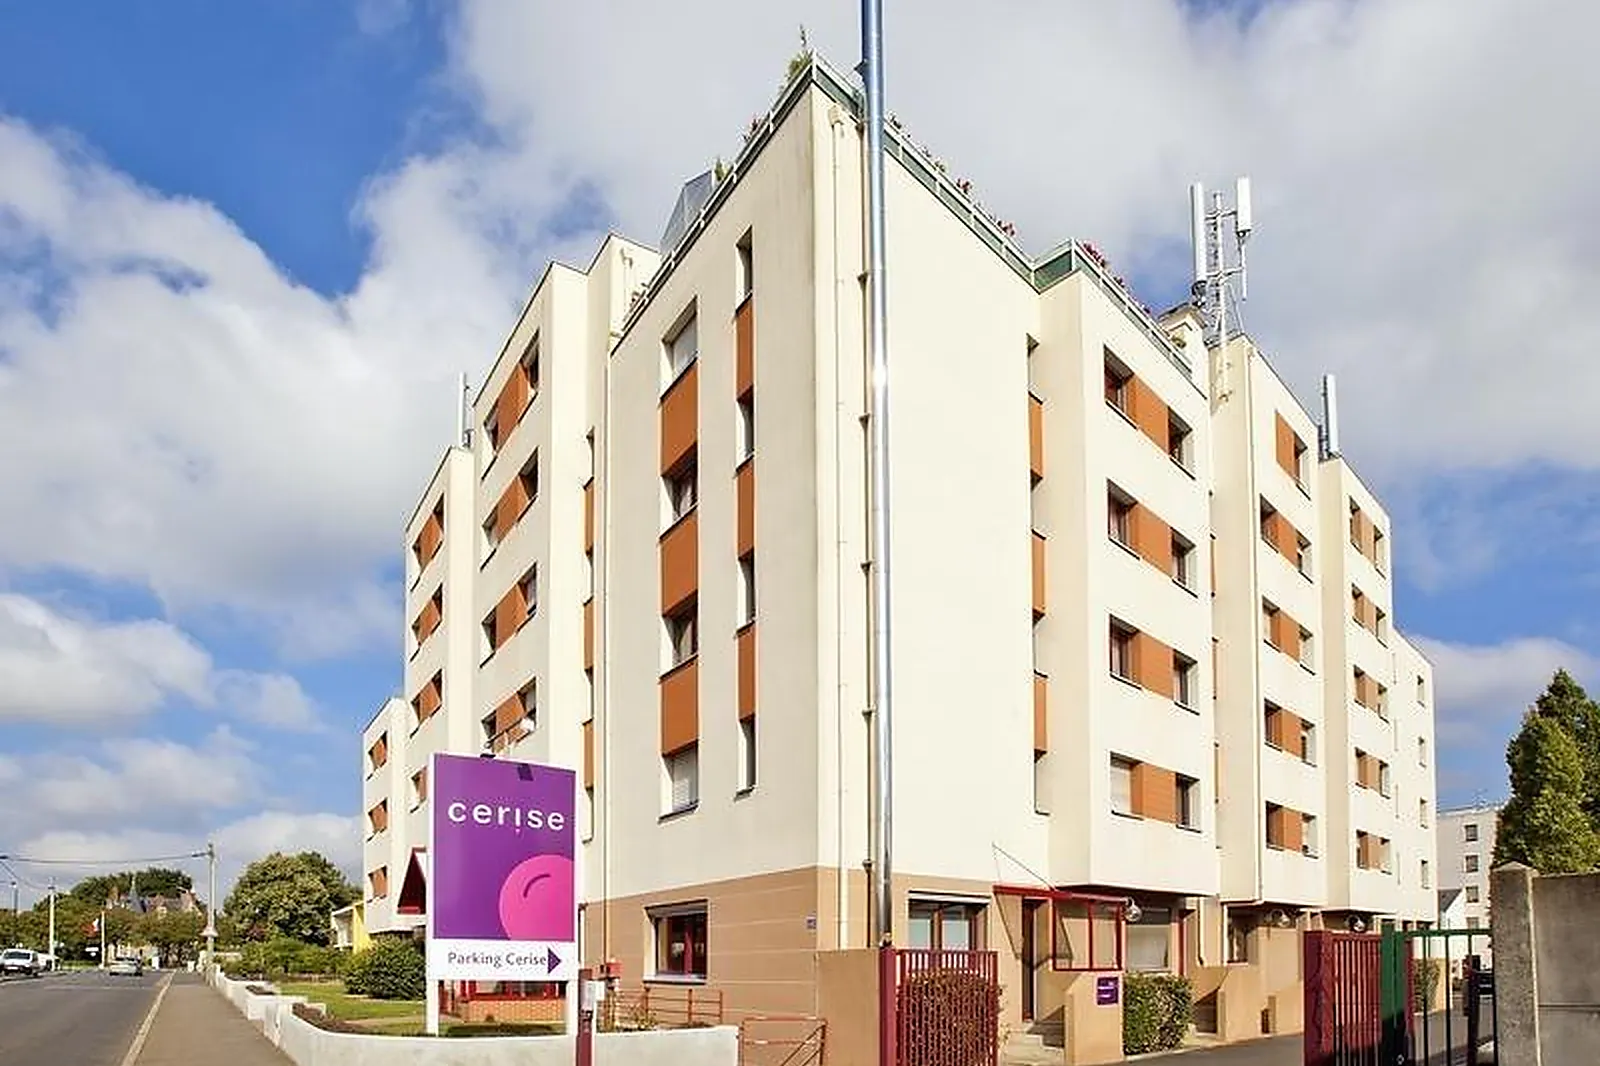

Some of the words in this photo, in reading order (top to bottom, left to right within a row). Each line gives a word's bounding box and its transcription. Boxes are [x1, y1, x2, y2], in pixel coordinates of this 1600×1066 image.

[448, 802, 565, 833] cerise
[447, 951, 502, 969] Parking
[505, 952, 547, 966] Cerise
